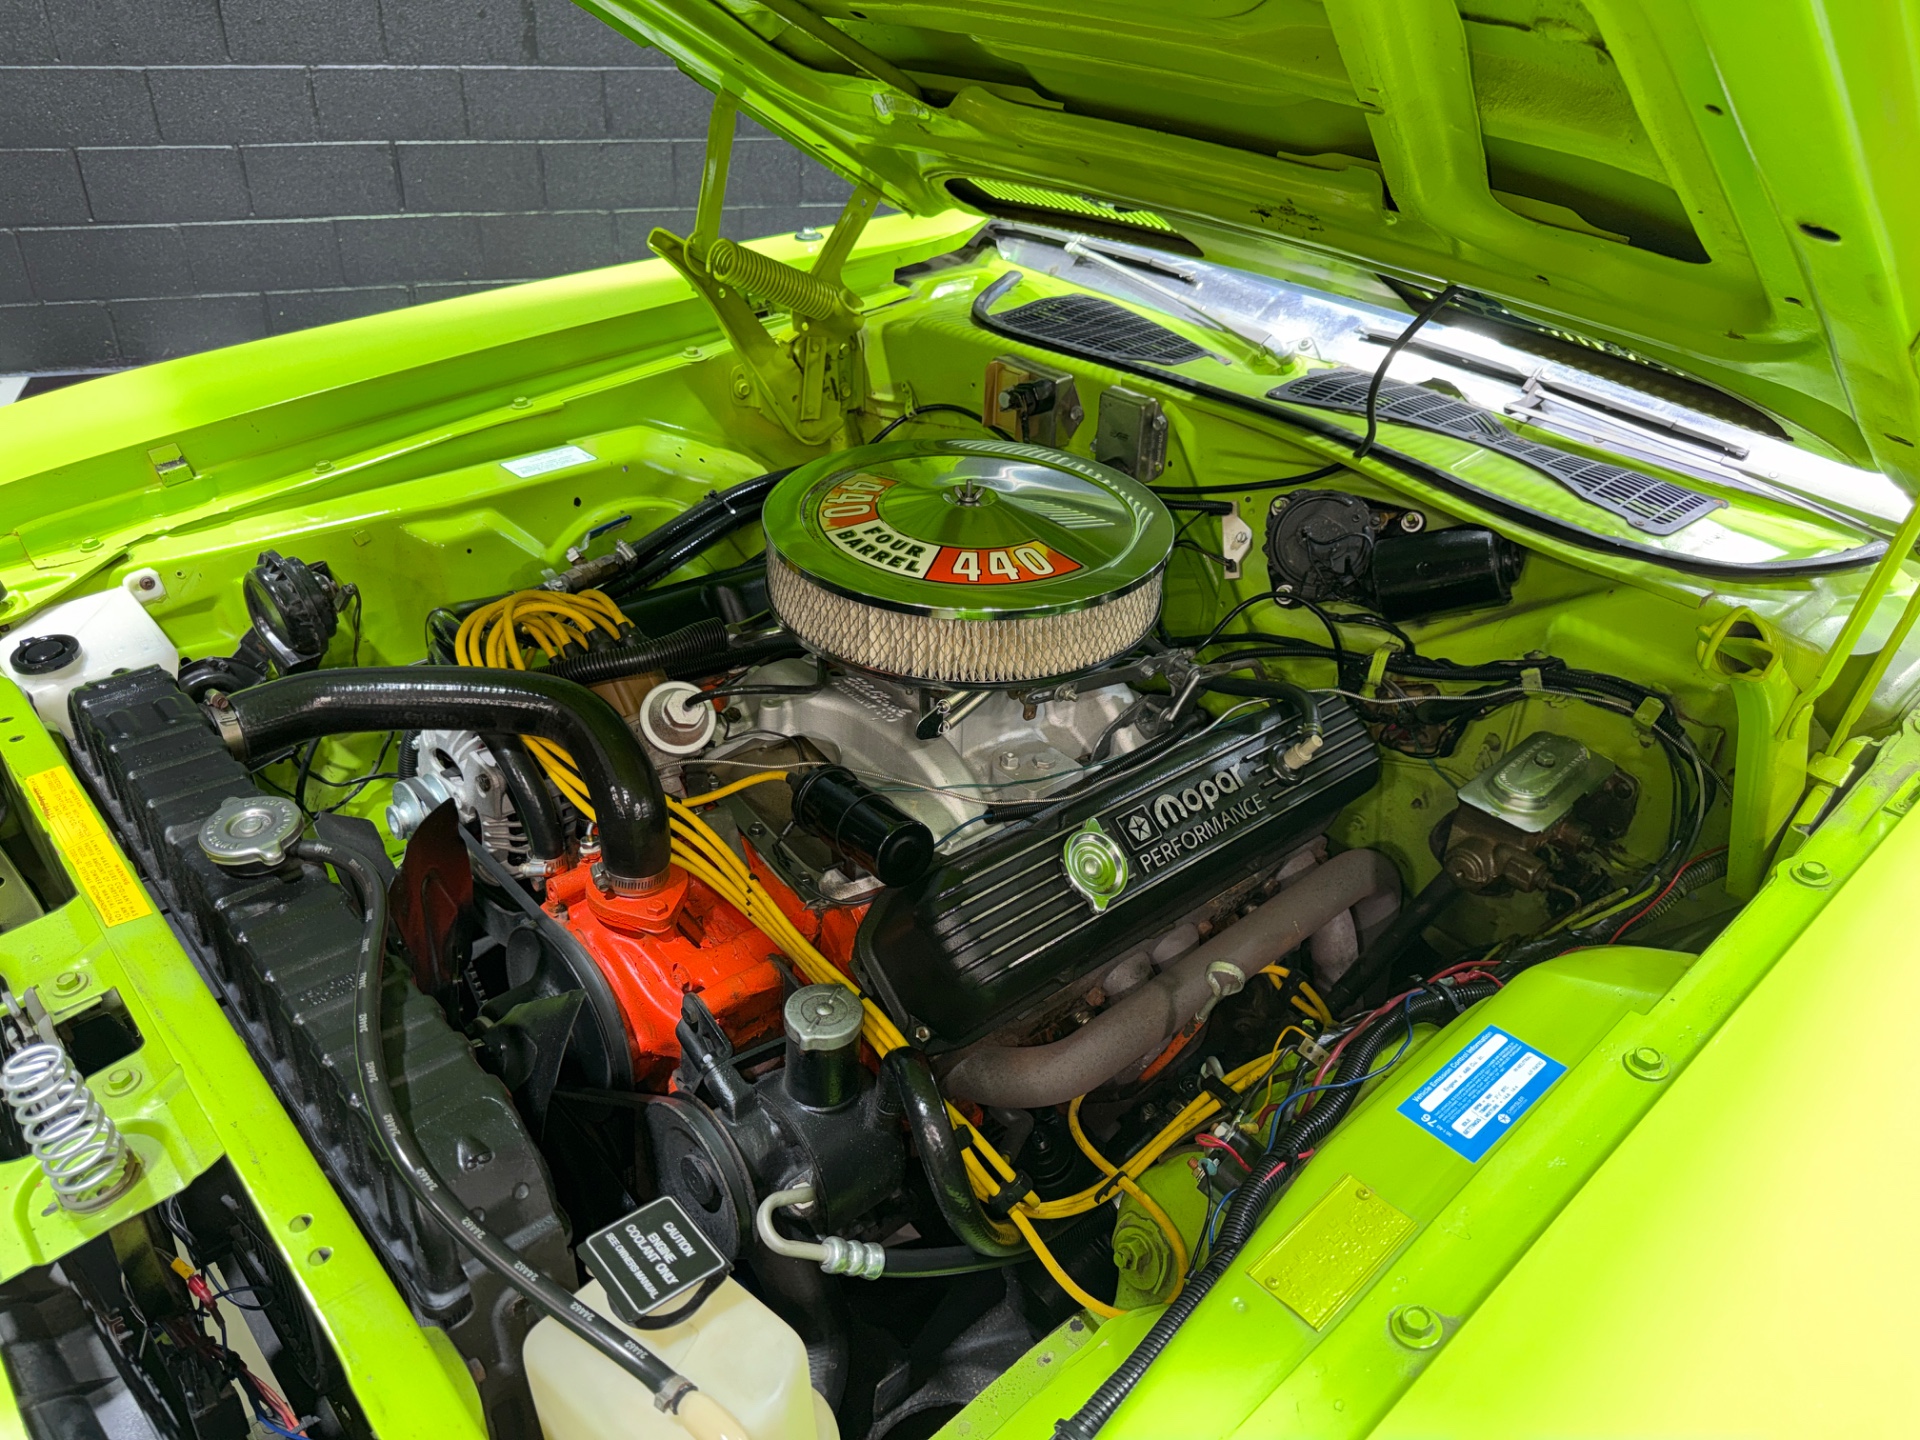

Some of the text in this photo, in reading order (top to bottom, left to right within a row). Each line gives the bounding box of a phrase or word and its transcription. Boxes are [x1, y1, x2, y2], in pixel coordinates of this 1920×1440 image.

[822, 473, 887, 519] 440
[837, 528, 920, 573] BARREL
[863, 522, 926, 559] FOUR
[952, 546, 1055, 583] 440
[1153, 763, 1247, 829] Mopar
[1139, 793, 1267, 873] PERFORMANCE
[113, 864, 129, 884] WARNING
[114, 882, 131, 904] COOLANT
[364, 1060, 379, 1083] 24462
[1412, 1030, 1493, 1102] Vehicle Emission Control Information
[383, 1113, 402, 1138] 24462
[1419, 1113, 1438, 1127] 76
[416, 1167, 439, 1192] 24462
[461, 1216, 487, 1240] 24462
[661, 1220, 696, 1257] CAUTION
[623, 1223, 678, 1286] COOLANT ONLY
[646, 1232, 677, 1264] ENGINE
[513, 1260, 539, 1282] 24462
[605, 1232, 660, 1299] SEE OWNERS MANUAL
[569, 1301, 596, 1323] 24462
[623, 1339, 649, 1360] 24462
